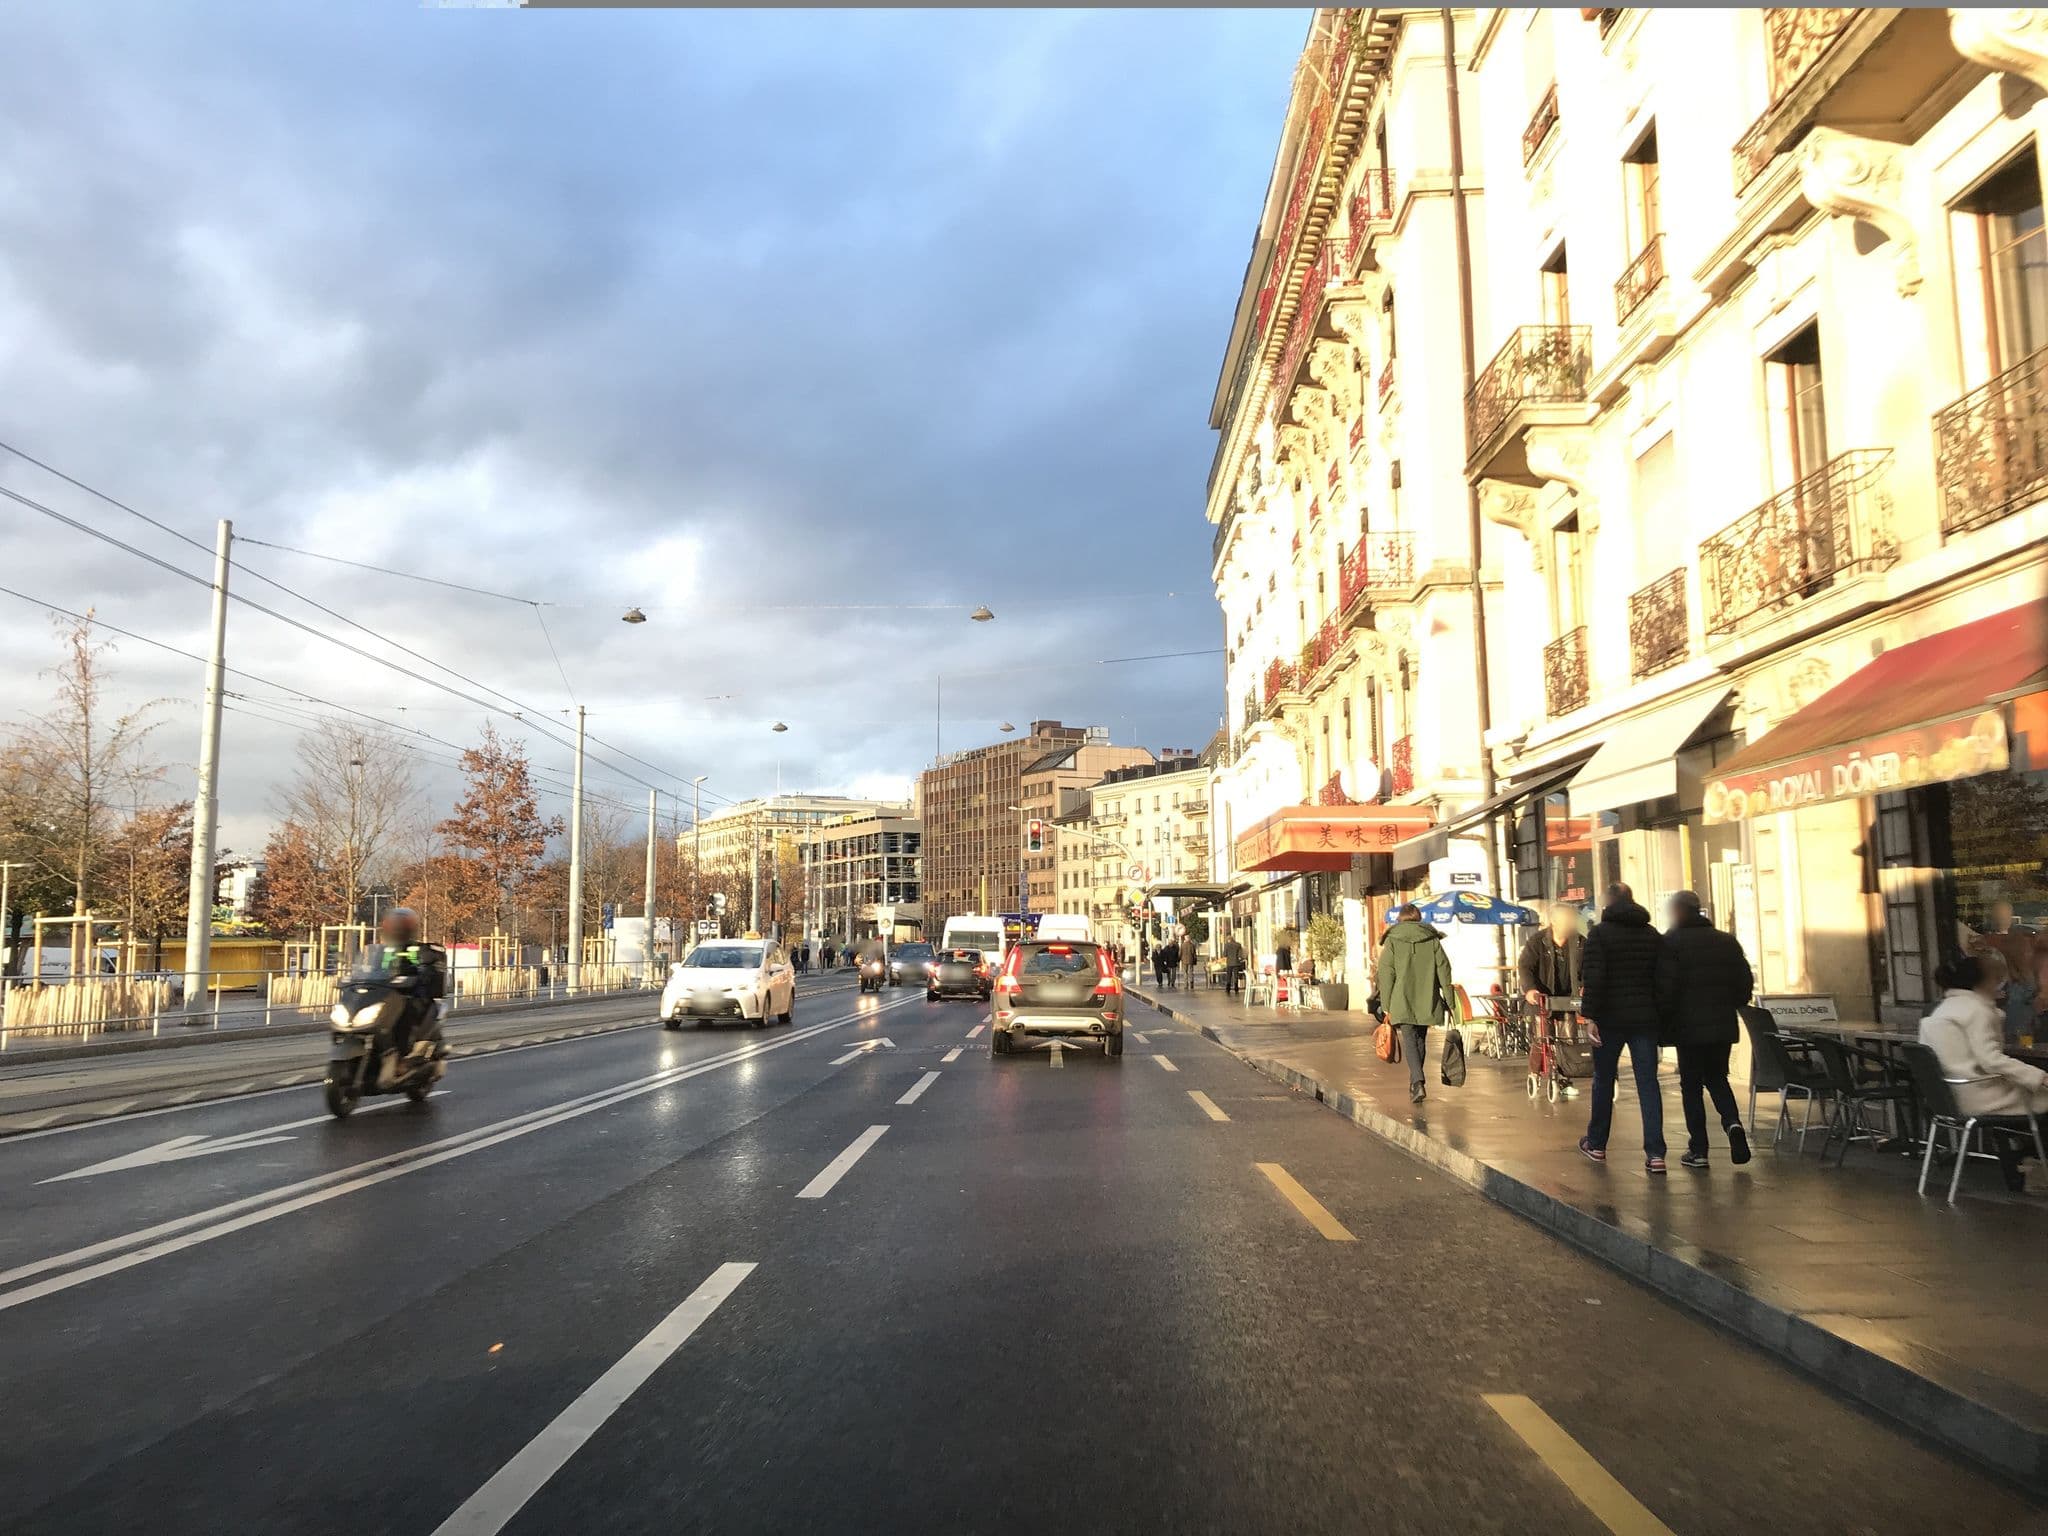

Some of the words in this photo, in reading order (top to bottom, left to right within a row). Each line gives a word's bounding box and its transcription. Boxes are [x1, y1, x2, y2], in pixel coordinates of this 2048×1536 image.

[1768, 770, 1825, 808] ROYAL
[1832, 751, 1901, 798] DÖNER
[1317, 823, 1399, 849] 美味園
[1772, 1007, 1799, 1015] ROYAL
[1800, 1004, 1829, 1015] DÖNER
